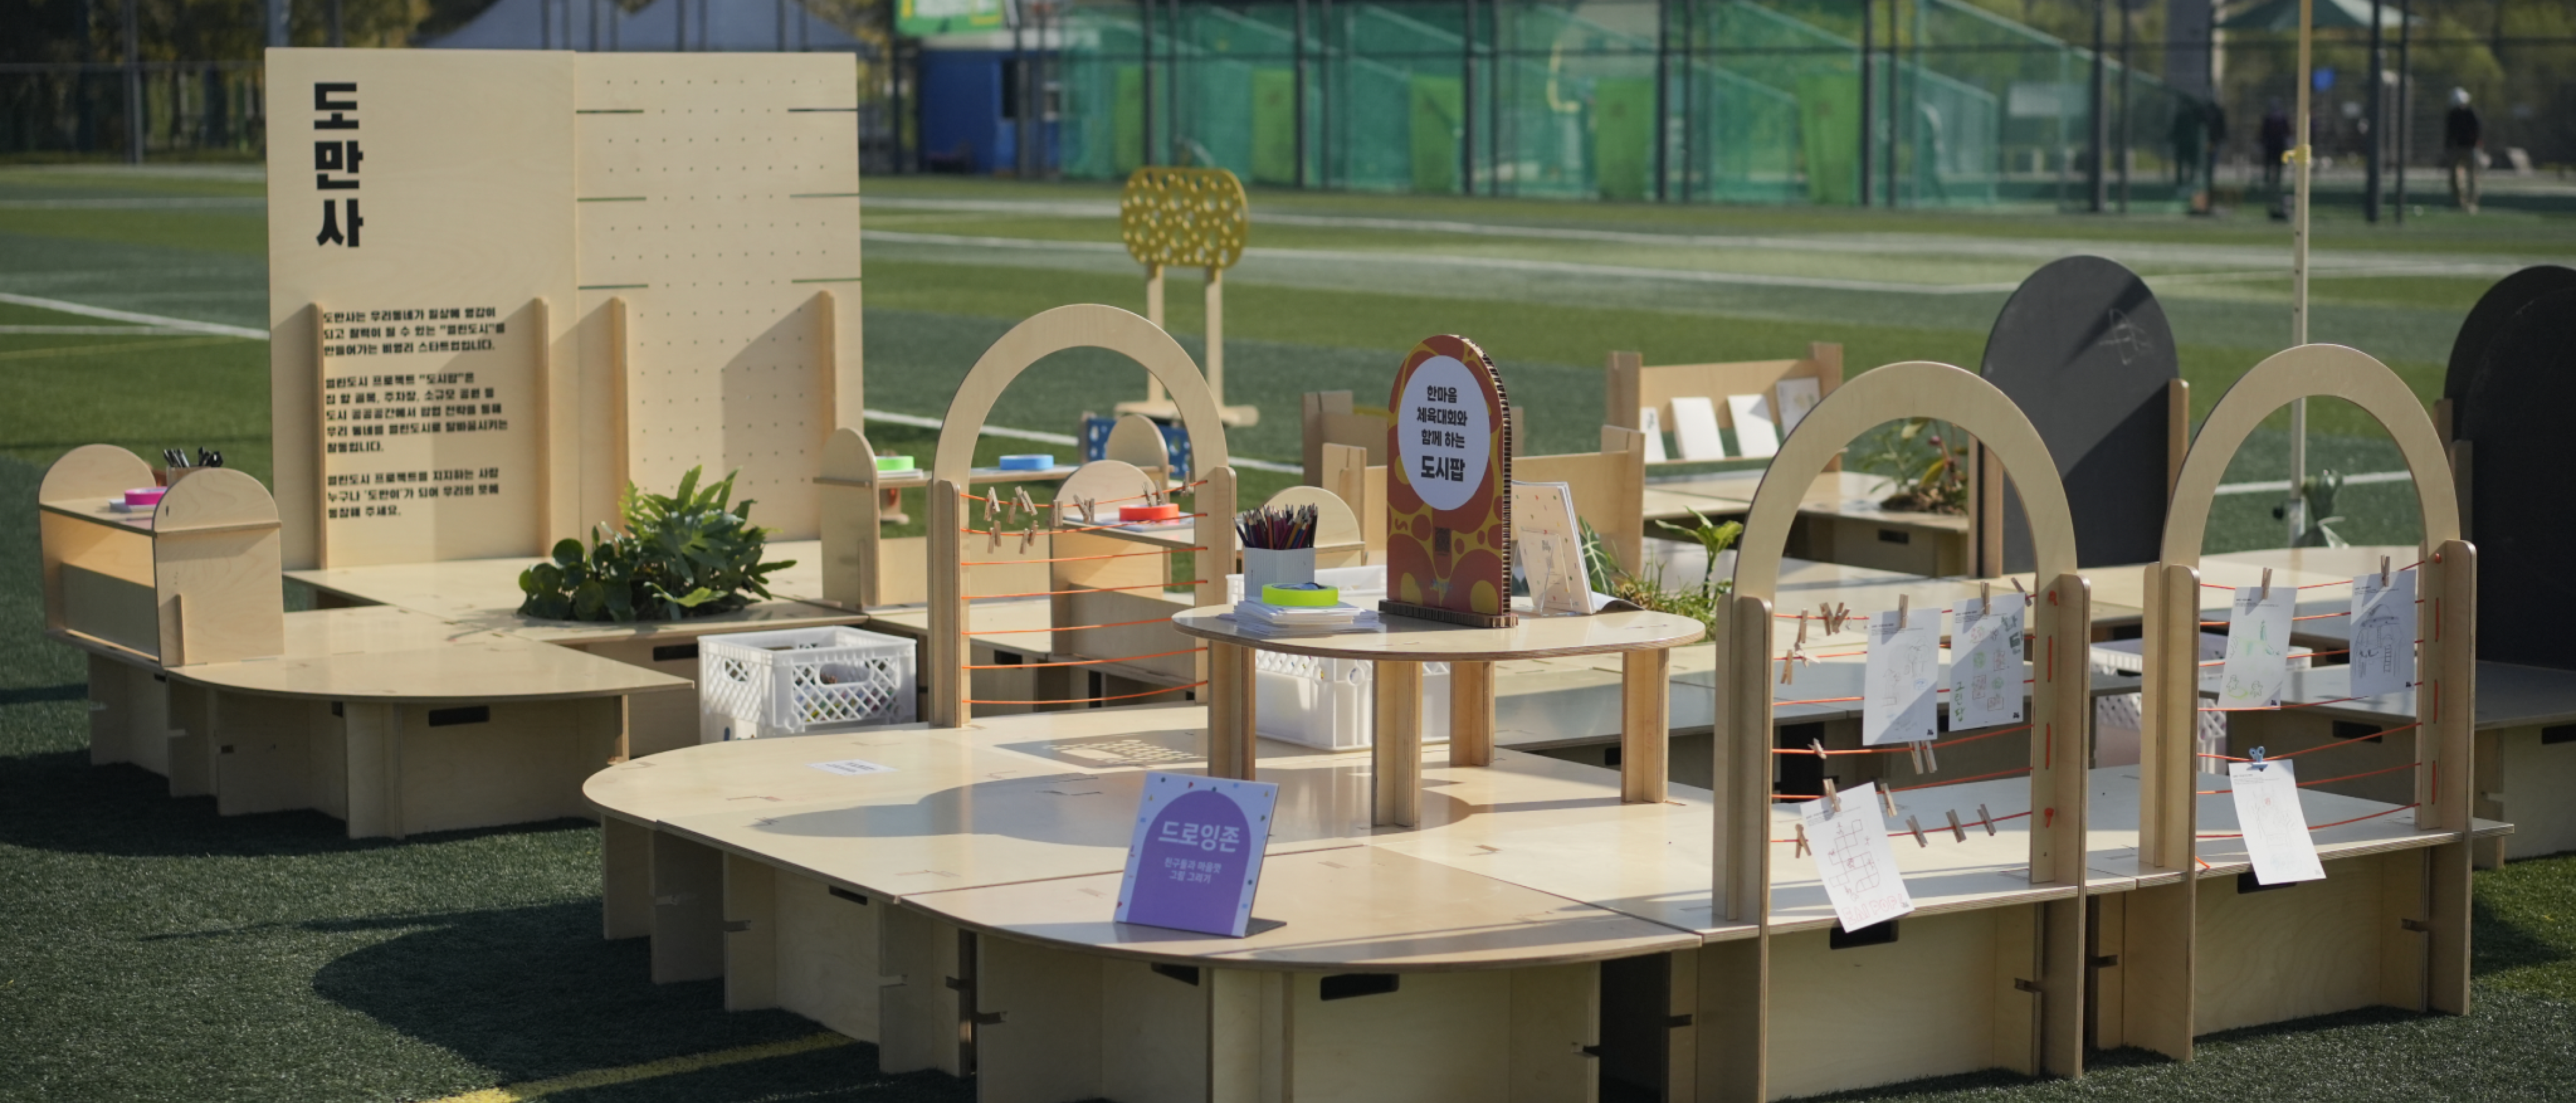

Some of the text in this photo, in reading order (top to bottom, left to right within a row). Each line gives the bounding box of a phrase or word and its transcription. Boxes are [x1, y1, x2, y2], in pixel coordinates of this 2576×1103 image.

[314, 83, 363, 248] 도만사
[1427, 385, 1458, 403] 한마음
[1416, 406, 1468, 427] 체육대회와
[1421, 429, 1465, 449] 함께 하는
[1421, 455, 1465, 481] 도시팝
[1158, 820, 1240, 853] 드로잉존
